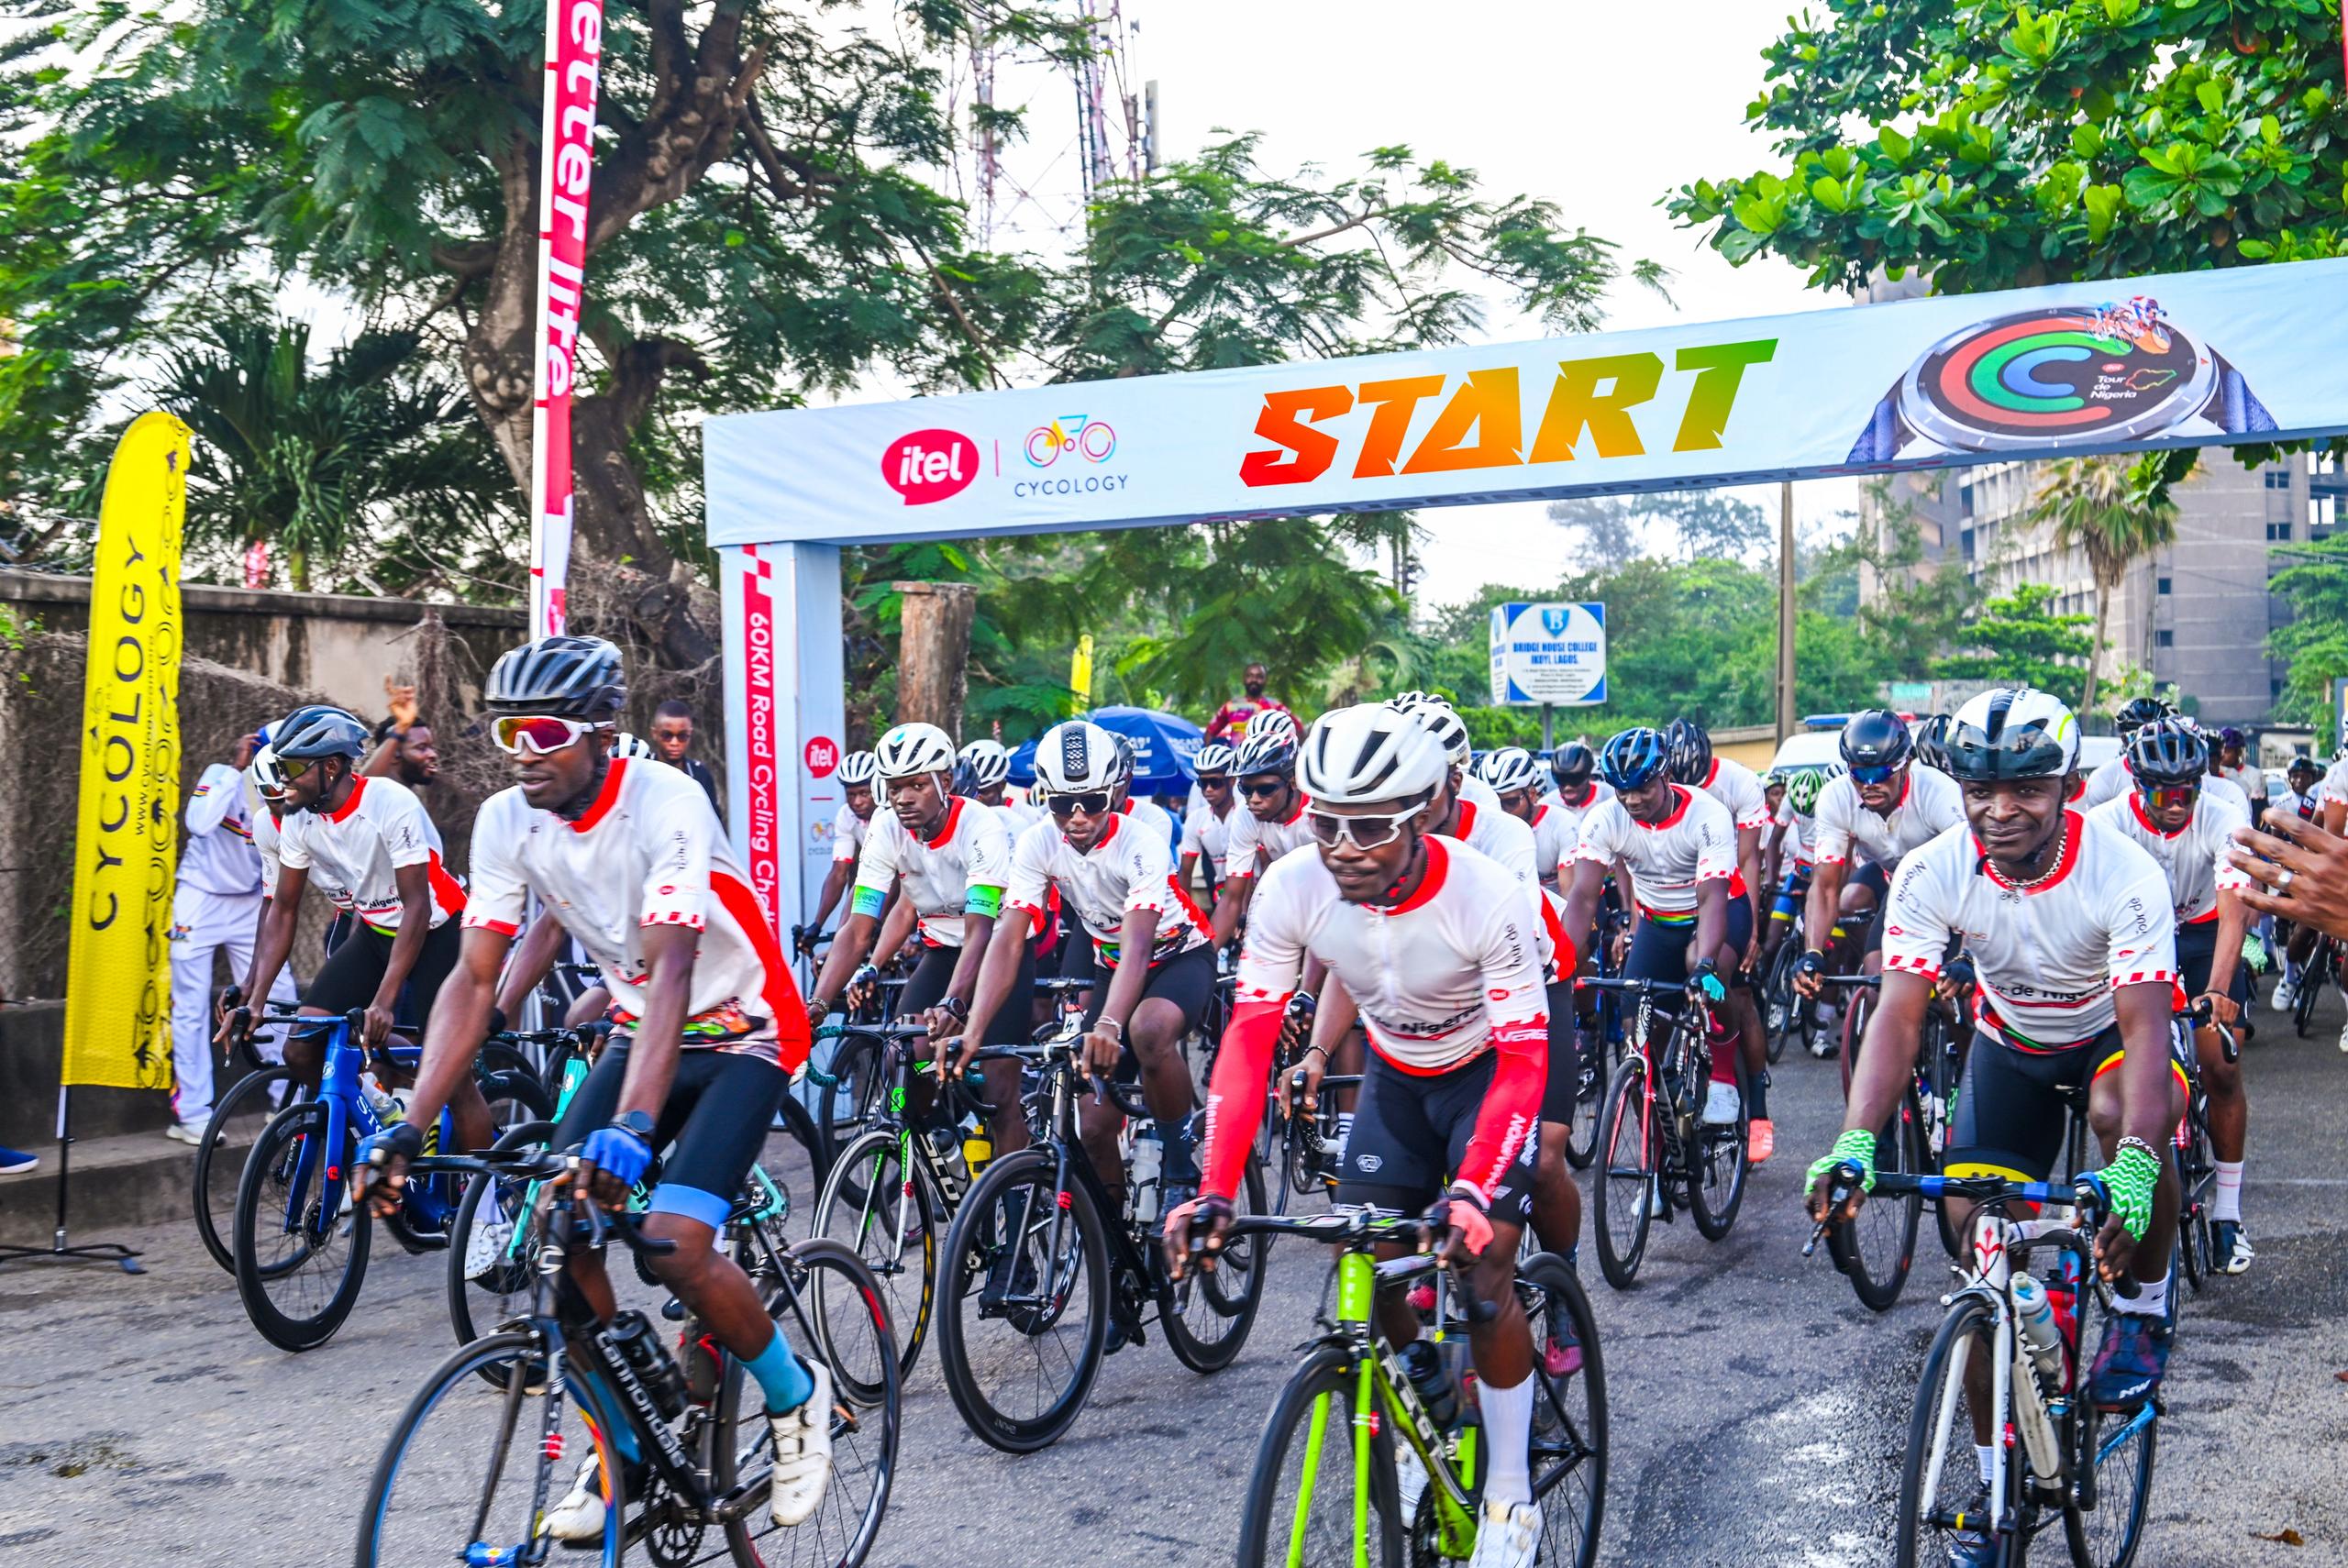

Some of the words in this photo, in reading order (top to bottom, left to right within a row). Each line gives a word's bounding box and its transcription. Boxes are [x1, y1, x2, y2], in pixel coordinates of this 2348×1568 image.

[548, 256, 583, 396] life
[2090, 390, 2137, 400] Nigeria
[2098, 375, 2126, 383] Tour
[1238, 337, 1779, 488] START
[899, 441, 963, 486] itel
[1014, 474, 1128, 498] CYCOLOGY
[749, 612, 771, 689] 60KM
[1513, 642, 1540, 652] BRIDGE
[1542, 642, 1566, 652] HOUSE
[1567, 642, 1598, 652] COLLEGE
[90, 534, 145, 932] CYCOLOGY
[752, 694, 773, 758] Road
[810, 744, 834, 767] itel
[749, 765, 774, 853] Cycling
[1896, 860, 1927, 903] Nigeria
[2129, 897, 2143, 912] de
[2012, 984, 2034, 997] de
[1656, 1100, 1686, 1164] GIANT
[594, 1331, 691, 1469] cannondale
